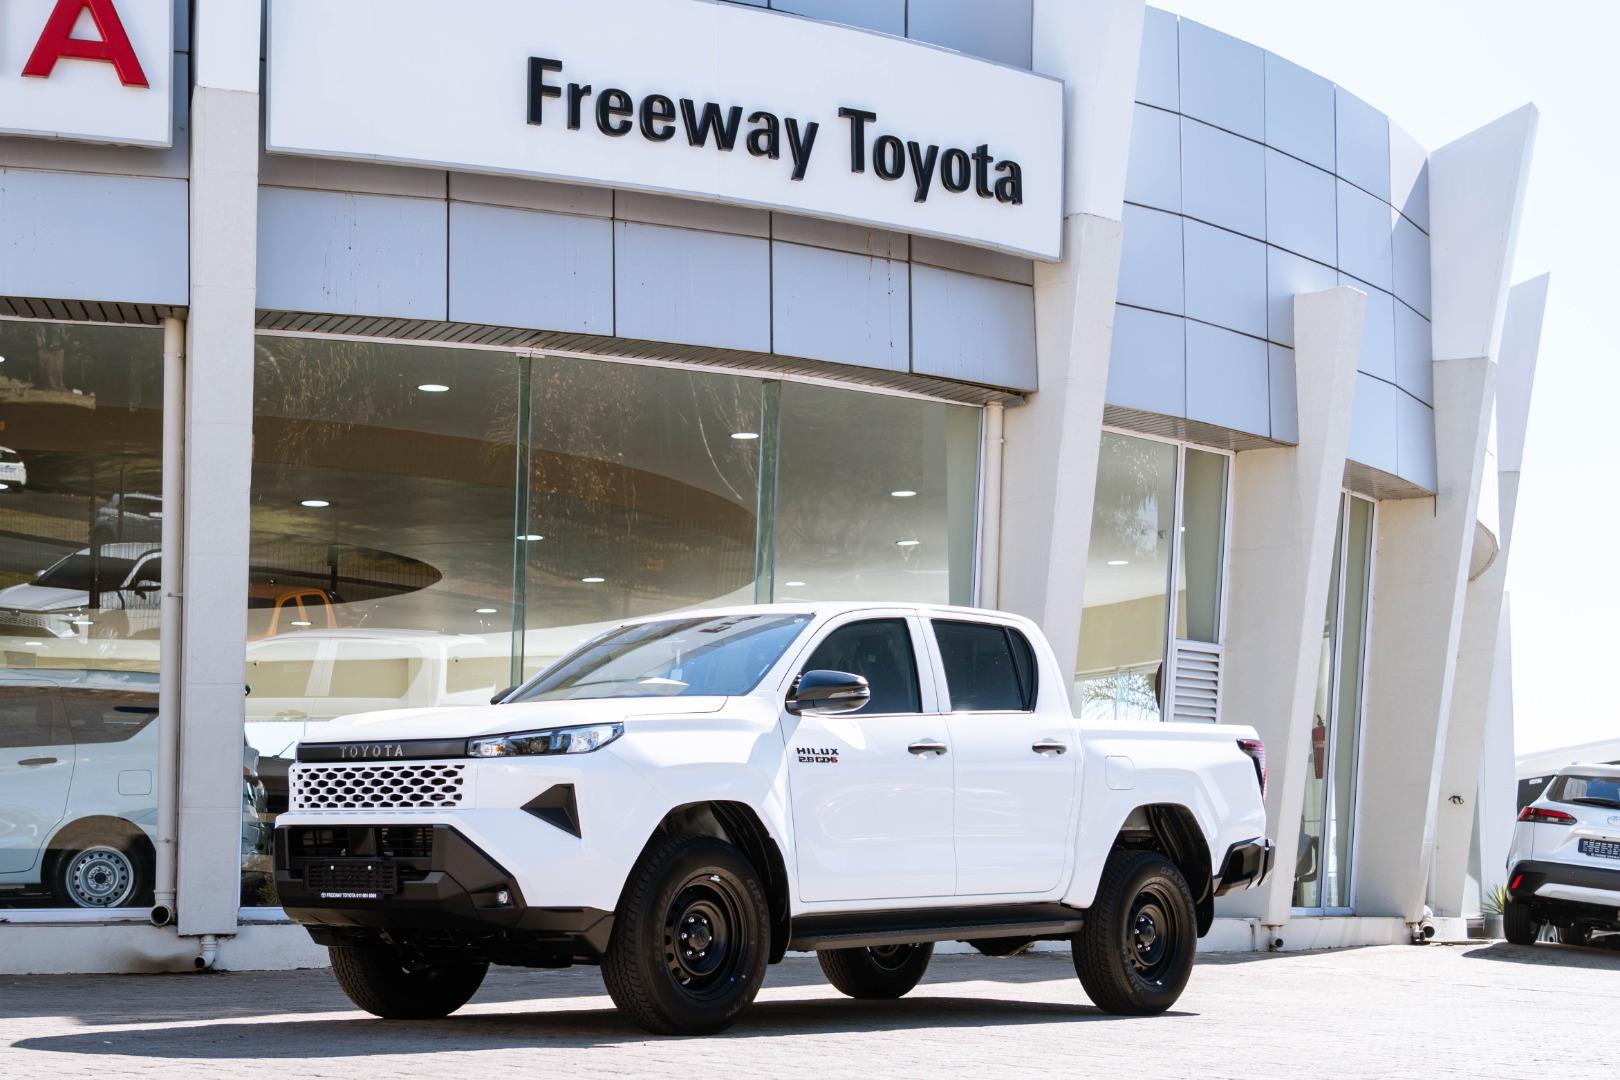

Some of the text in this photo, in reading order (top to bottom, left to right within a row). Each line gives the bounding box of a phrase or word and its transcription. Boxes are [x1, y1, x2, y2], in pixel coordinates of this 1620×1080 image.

[21, 0, 150, 89] A
[526, 56, 1024, 206] Freeway Toyota
[339, 744, 404, 759] TOYOTA
[796, 747, 839, 756] HILUX
